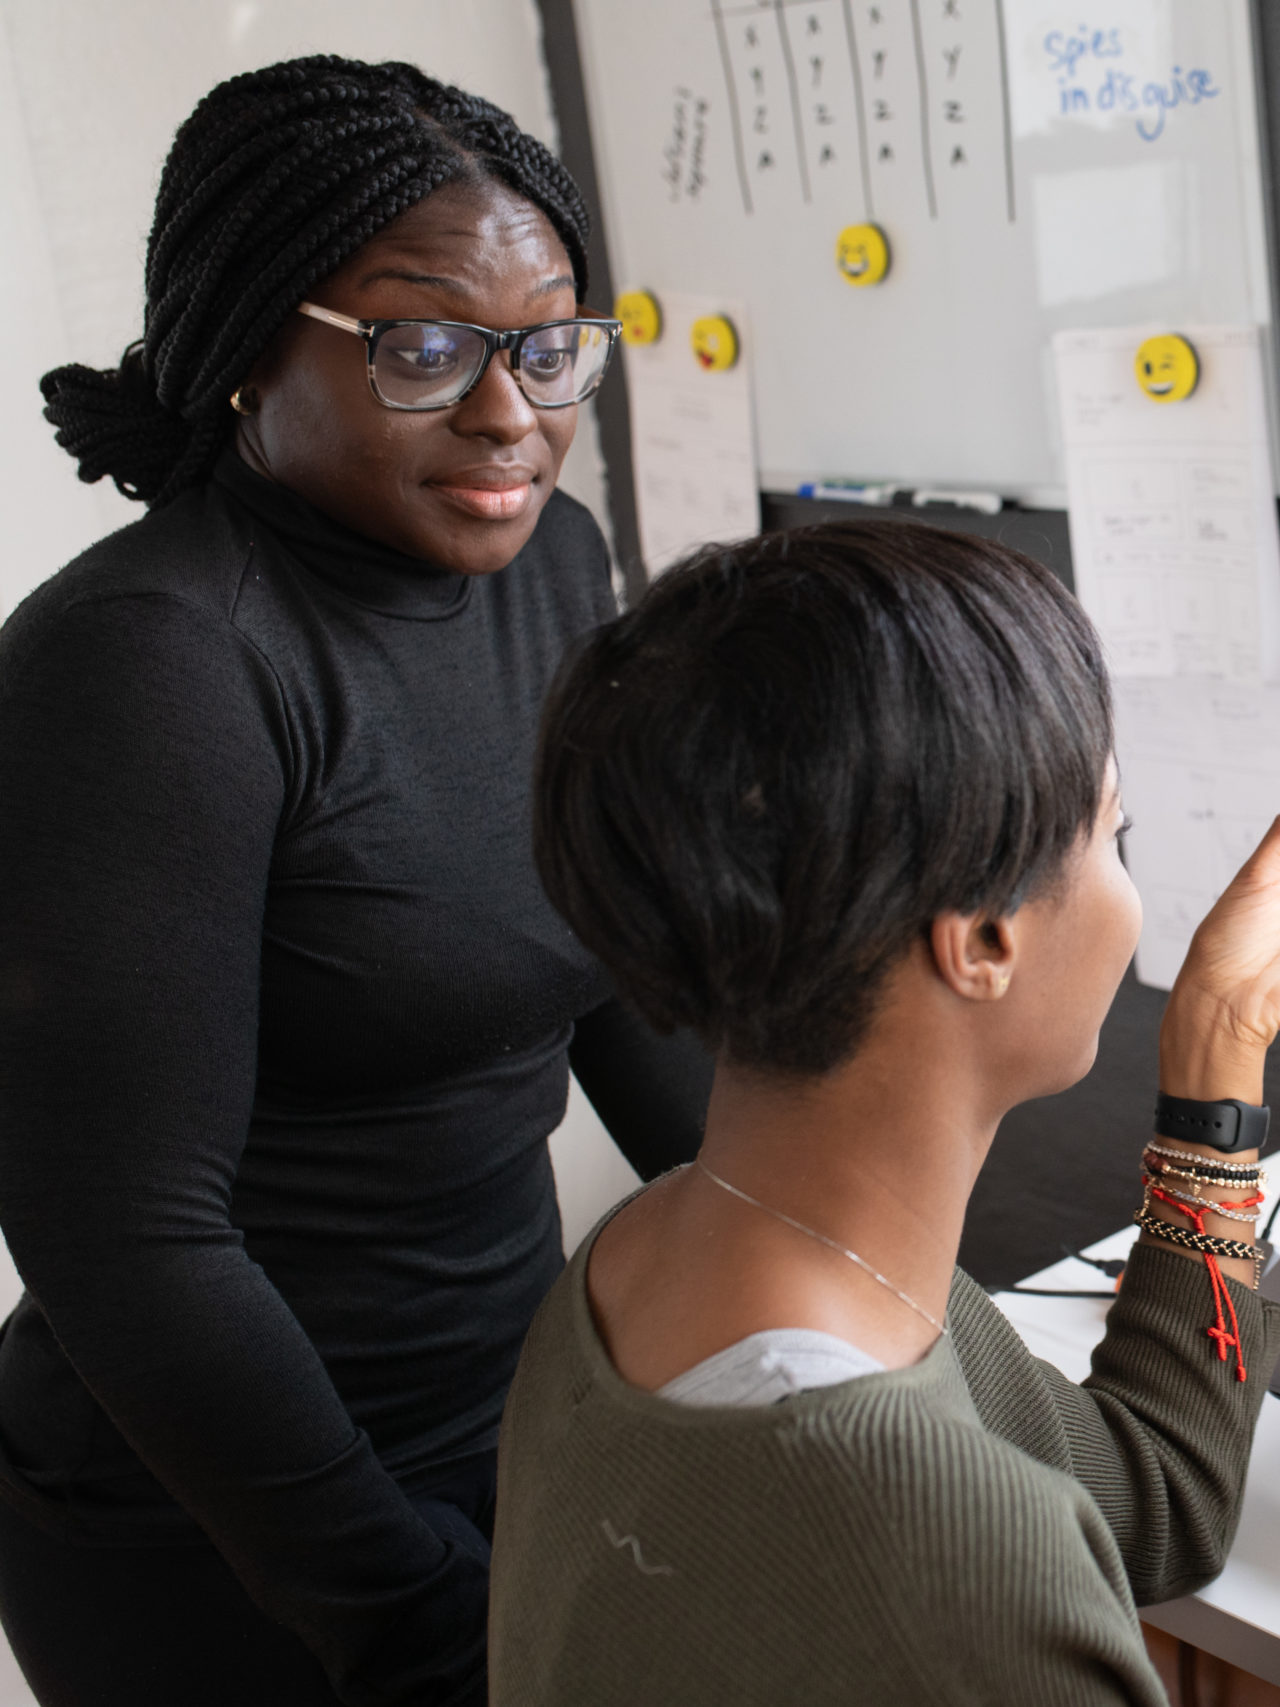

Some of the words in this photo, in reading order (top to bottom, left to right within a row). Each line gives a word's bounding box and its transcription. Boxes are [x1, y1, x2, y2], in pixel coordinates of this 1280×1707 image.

[943, 44, 961, 82] Y
[1044, 23, 1124, 77] Spies
[944, 100, 964, 123] Z
[1057, 76, 1091, 116] in
[1097, 65, 1220, 142] disguise
